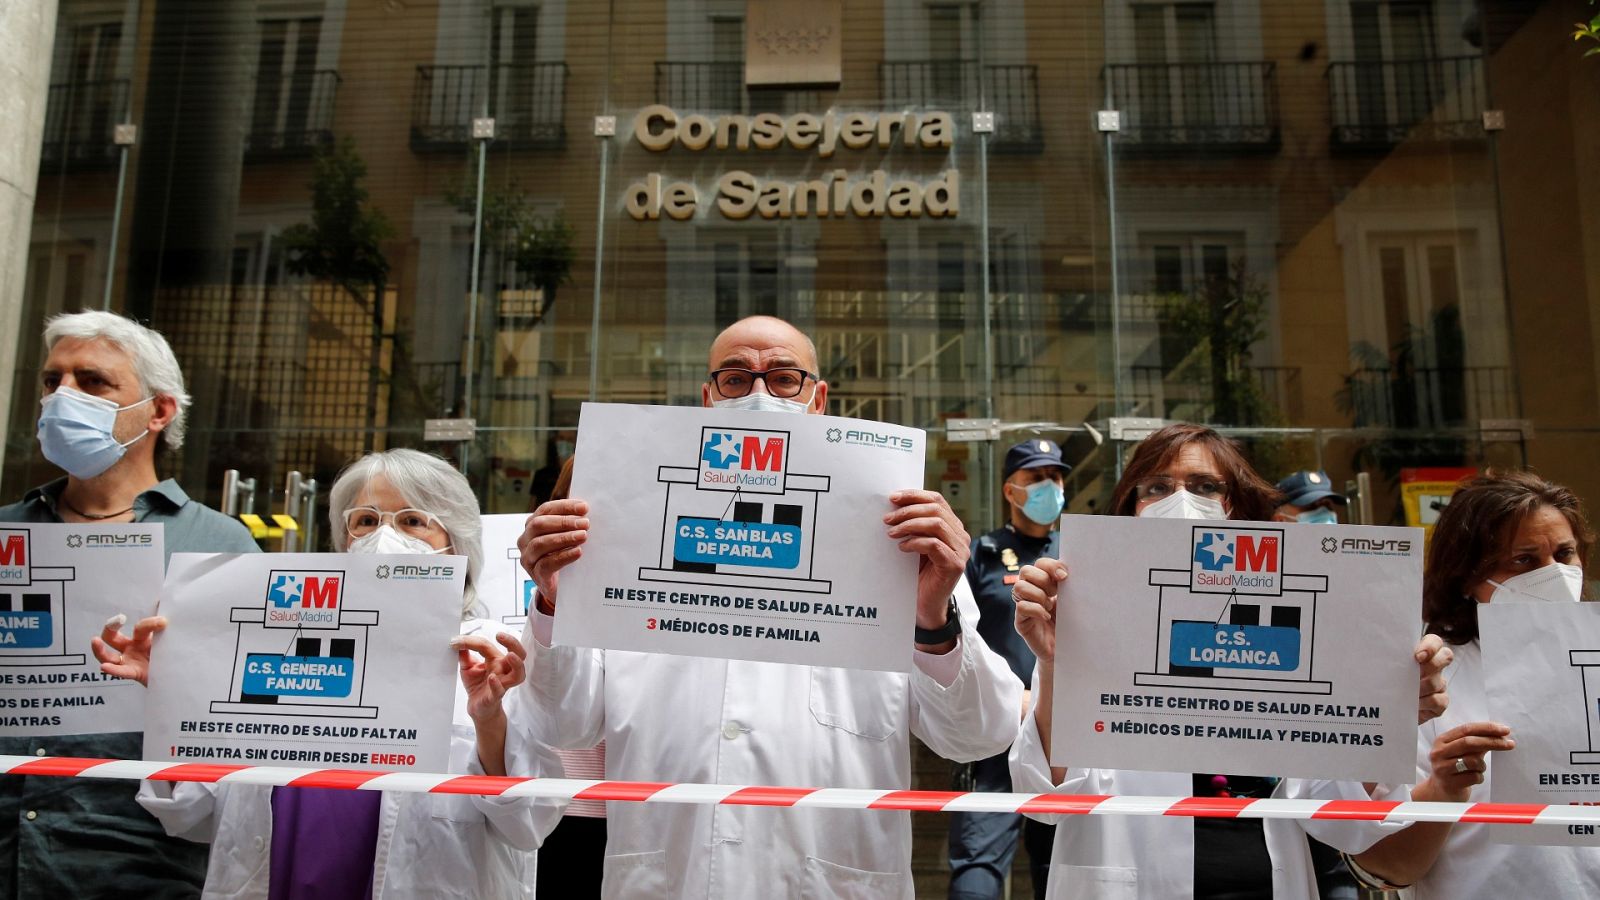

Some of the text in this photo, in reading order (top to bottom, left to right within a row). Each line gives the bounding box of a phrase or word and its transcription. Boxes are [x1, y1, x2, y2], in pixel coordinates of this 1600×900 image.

[626, 169, 959, 220] de Sanidad
[846, 430, 913, 448] AMYTS
[86, 534, 152, 544] AMYTS
[680, 525, 793, 545] C.S. SAN BLAS
[696, 541, 773, 559] DE PARLA
[1341, 538, 1411, 551] AMYTS
[393, 565, 454, 576] AMYTS
[604, 587, 877, 619] EN ESTE CENTRO DE SALUD FALTAN
[646, 617, 821, 643] 3 MÉDICOS DE FAMILIA
[1215, 630, 1251, 646] C.S.
[1190, 647, 1281, 666] LORANCA
[16, 673, 68, 684] SALUD
[248, 662, 346, 677] C.S. GENERAL
[266, 677, 324, 691] FANJUL
[20, 698, 40, 708] DE
[42, 695, 105, 708] FAMILIA
[1100, 693, 1380, 719] EN ESTE CENTRO DE SALUD FALTAN
[180, 721, 417, 740] EN ESTE CENTRO DE SALUD FALTAN
[1094, 719, 1384, 746] 6 MÉDICOS DE FAMILIA Y PEDIATRAS
[170, 746, 416, 766] 1 PEDIATRA SIN CUBRIR DESDE ENERO
[1539, 773, 1600, 785] EN ESTE
